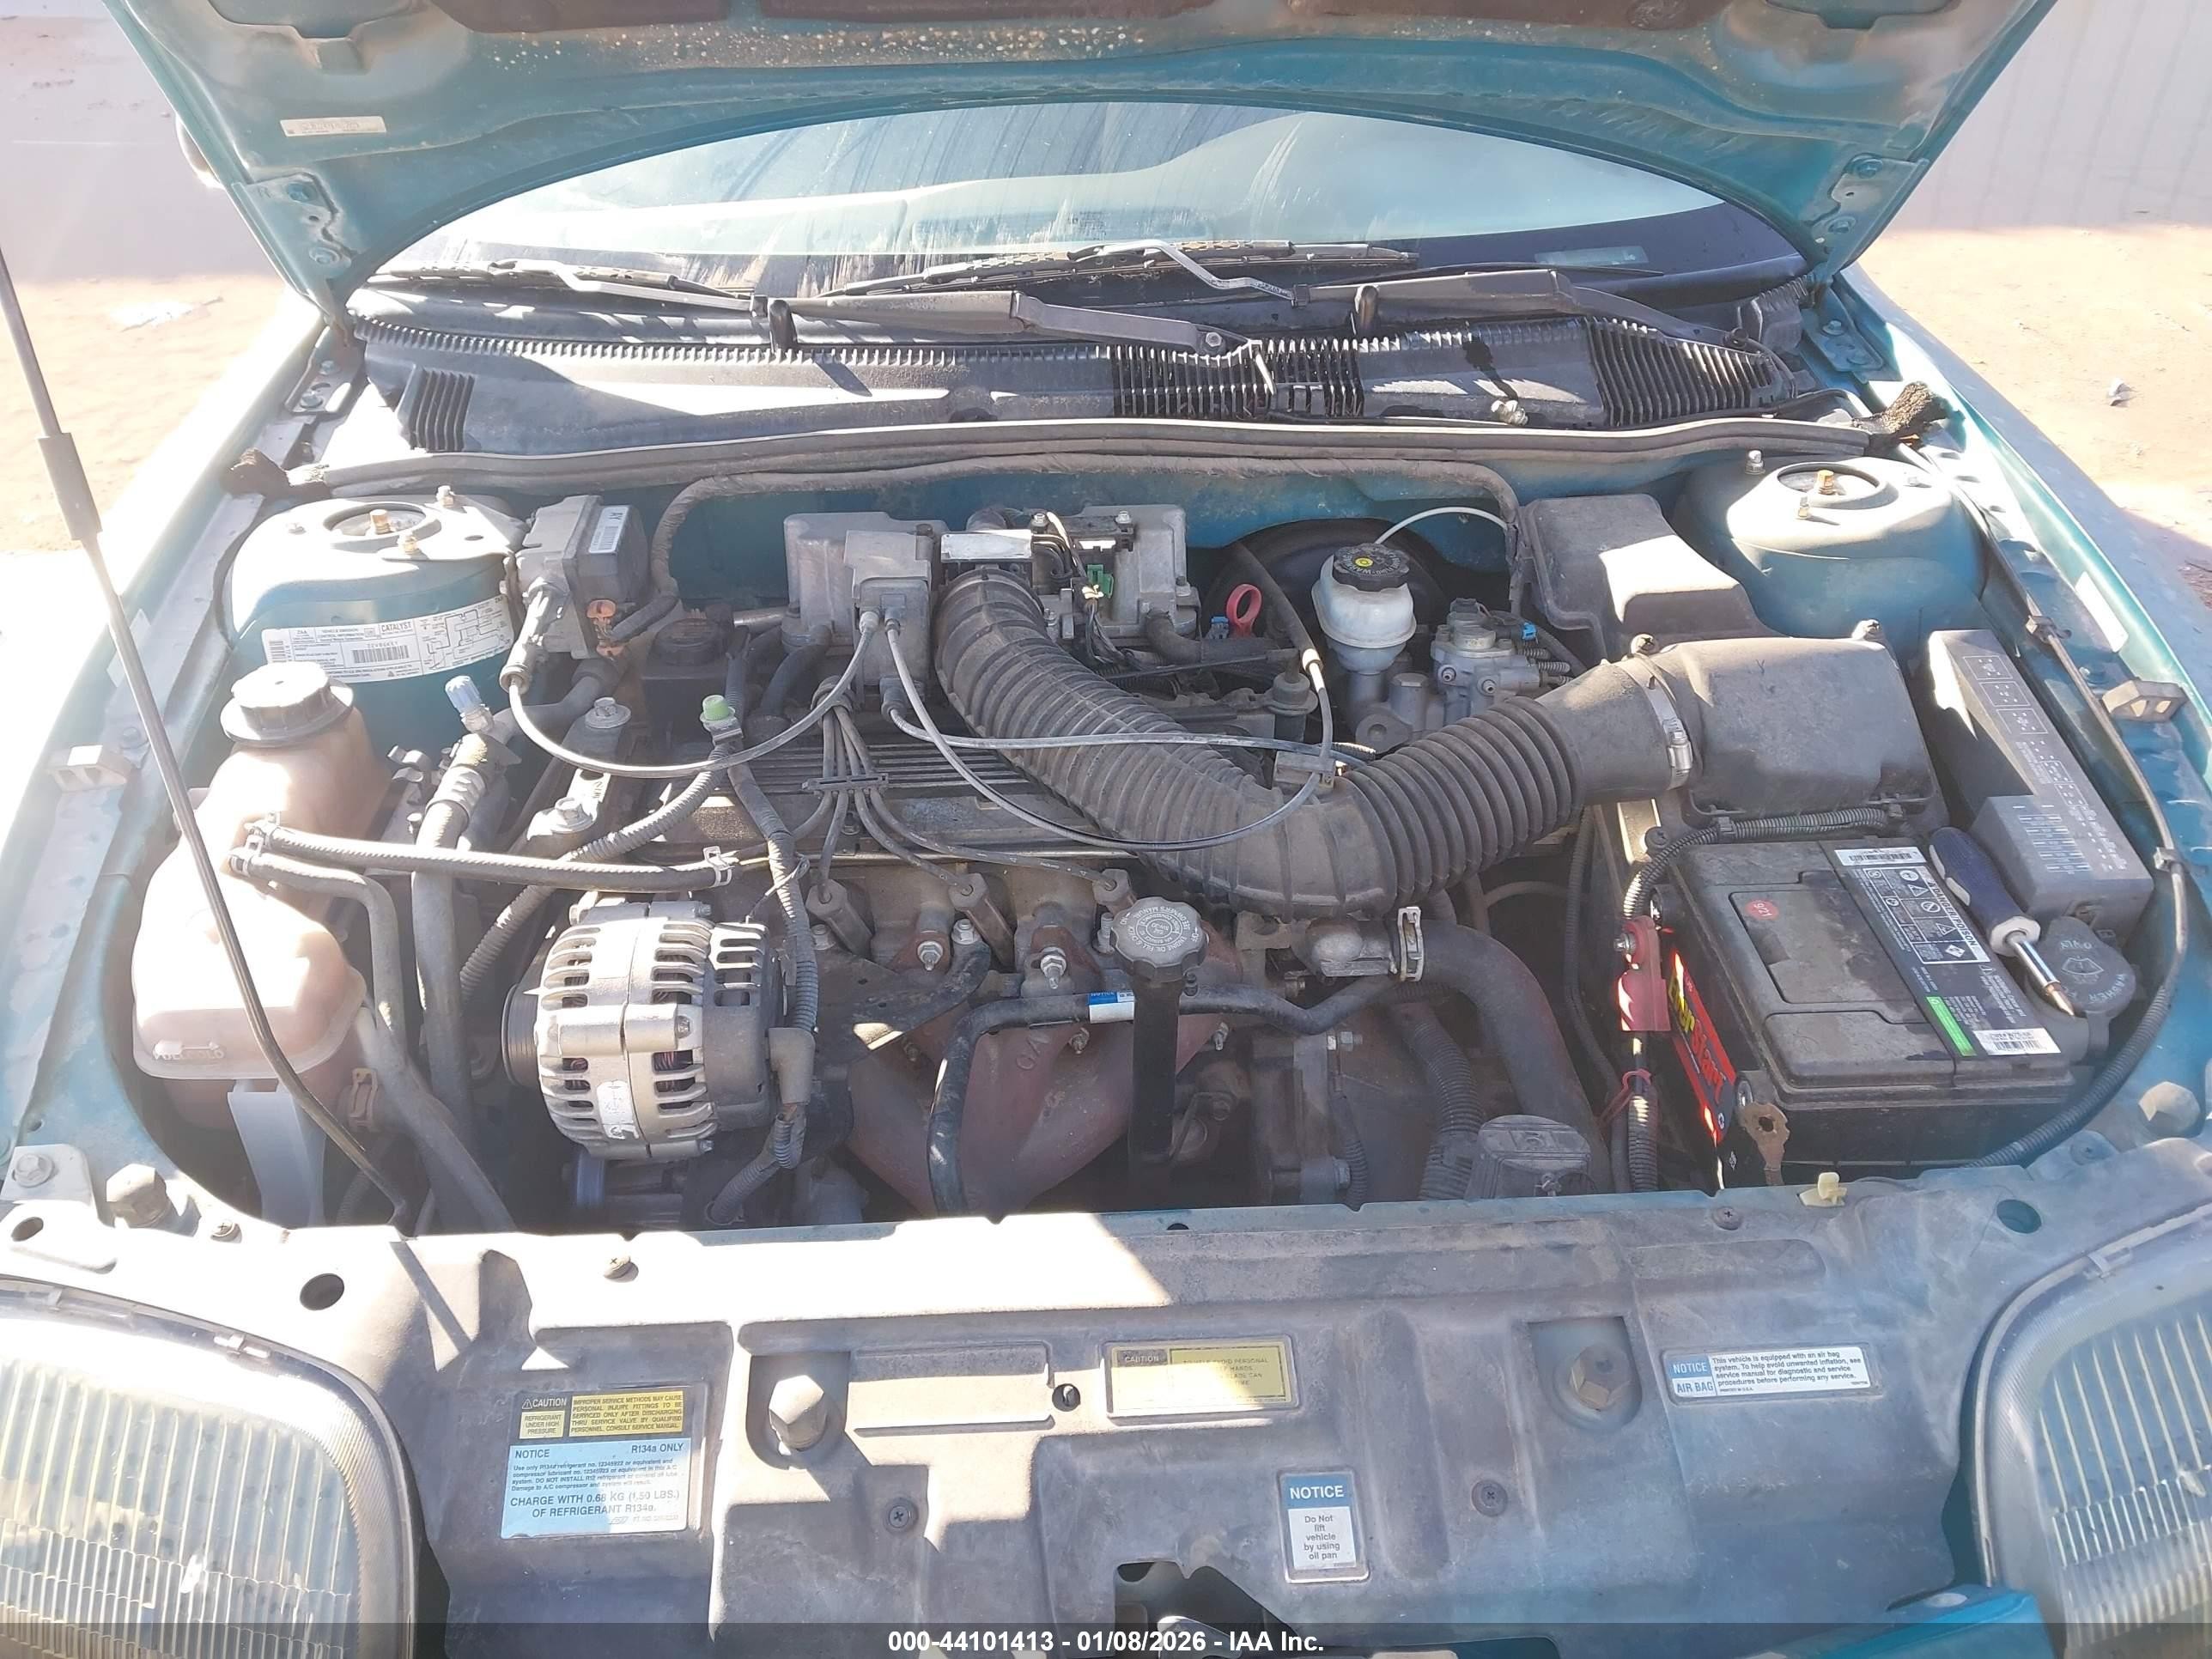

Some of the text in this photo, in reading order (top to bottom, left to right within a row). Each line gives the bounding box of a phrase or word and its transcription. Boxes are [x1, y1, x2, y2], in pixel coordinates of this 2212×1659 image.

[381, 622, 412, 633] CATALYST
[1133, 906, 1158, 920] MANUAL
[1934, 887, 1978, 946] DANGER/POISON
[1142, 943, 1154, 952] FILL
[2087, 974, 2128, 1004] WASHER
[1673, 1362, 1708, 1374] NOTICE
[1752, 1363, 1765, 1371] help
[1677, 1381, 1714, 1393] AIR BAG
[1717, 1378, 1755, 1387] procedures
[1756, 1376, 1778, 1384] before
[1778, 1375, 1816, 1383] performing
[532, 1397, 567, 1407] CAUTION
[515, 1443, 684, 1459] NOTICE R134a ONLY
[510, 1490, 680, 1506] CHARGE WITH 0.68 KG (1.50 LBS.)
[1290, 1485, 1345, 1499] NOTICE
[532, 1508, 547, 1518] OF
[550, 1504, 622, 1517] REFRIGERANT
[1306, 1533, 1336, 1541] vehicle
[1304, 1542, 1340, 1553] by using
[1321, 1552, 1338, 1560] pan
